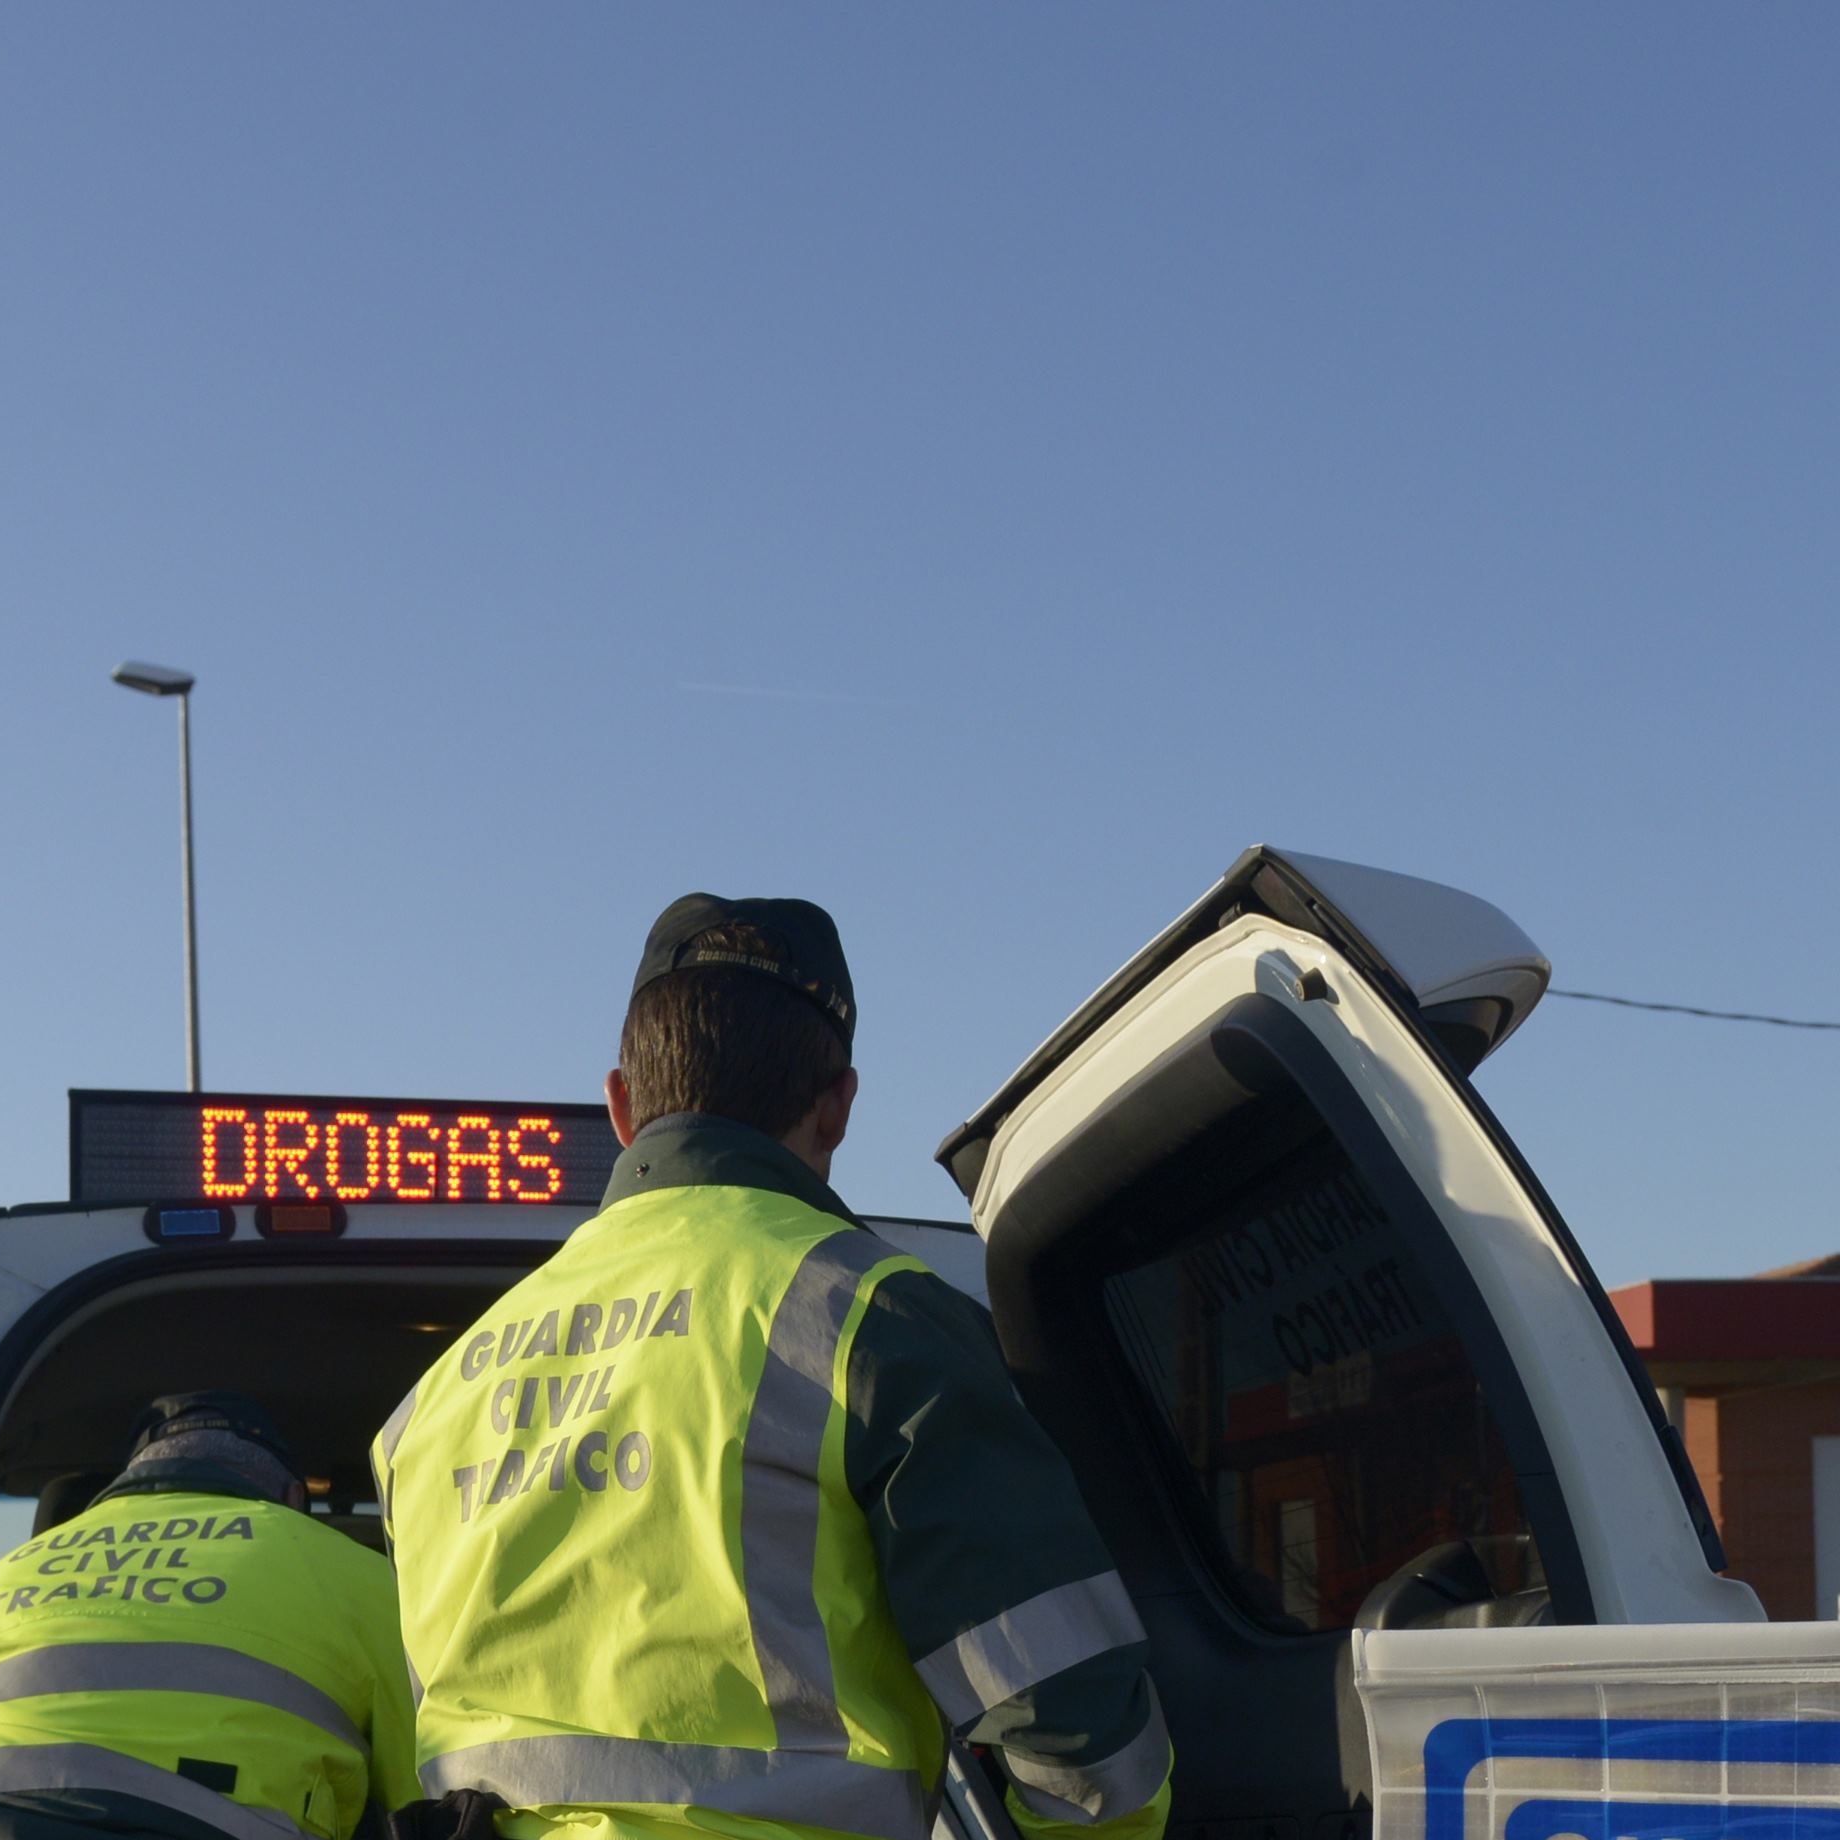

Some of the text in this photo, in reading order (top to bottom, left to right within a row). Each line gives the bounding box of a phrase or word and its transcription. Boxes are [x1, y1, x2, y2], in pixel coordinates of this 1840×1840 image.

[750, 956, 780, 974] CIVIL
[201, 1108, 561, 1200] DROGAS
[460, 1287, 694, 1382] GUARDIA
[490, 1364, 616, 1435] CIVIL
[9, 1516, 254, 1563] GUARDIA
[37, 1547, 192, 1576] CIVIL
